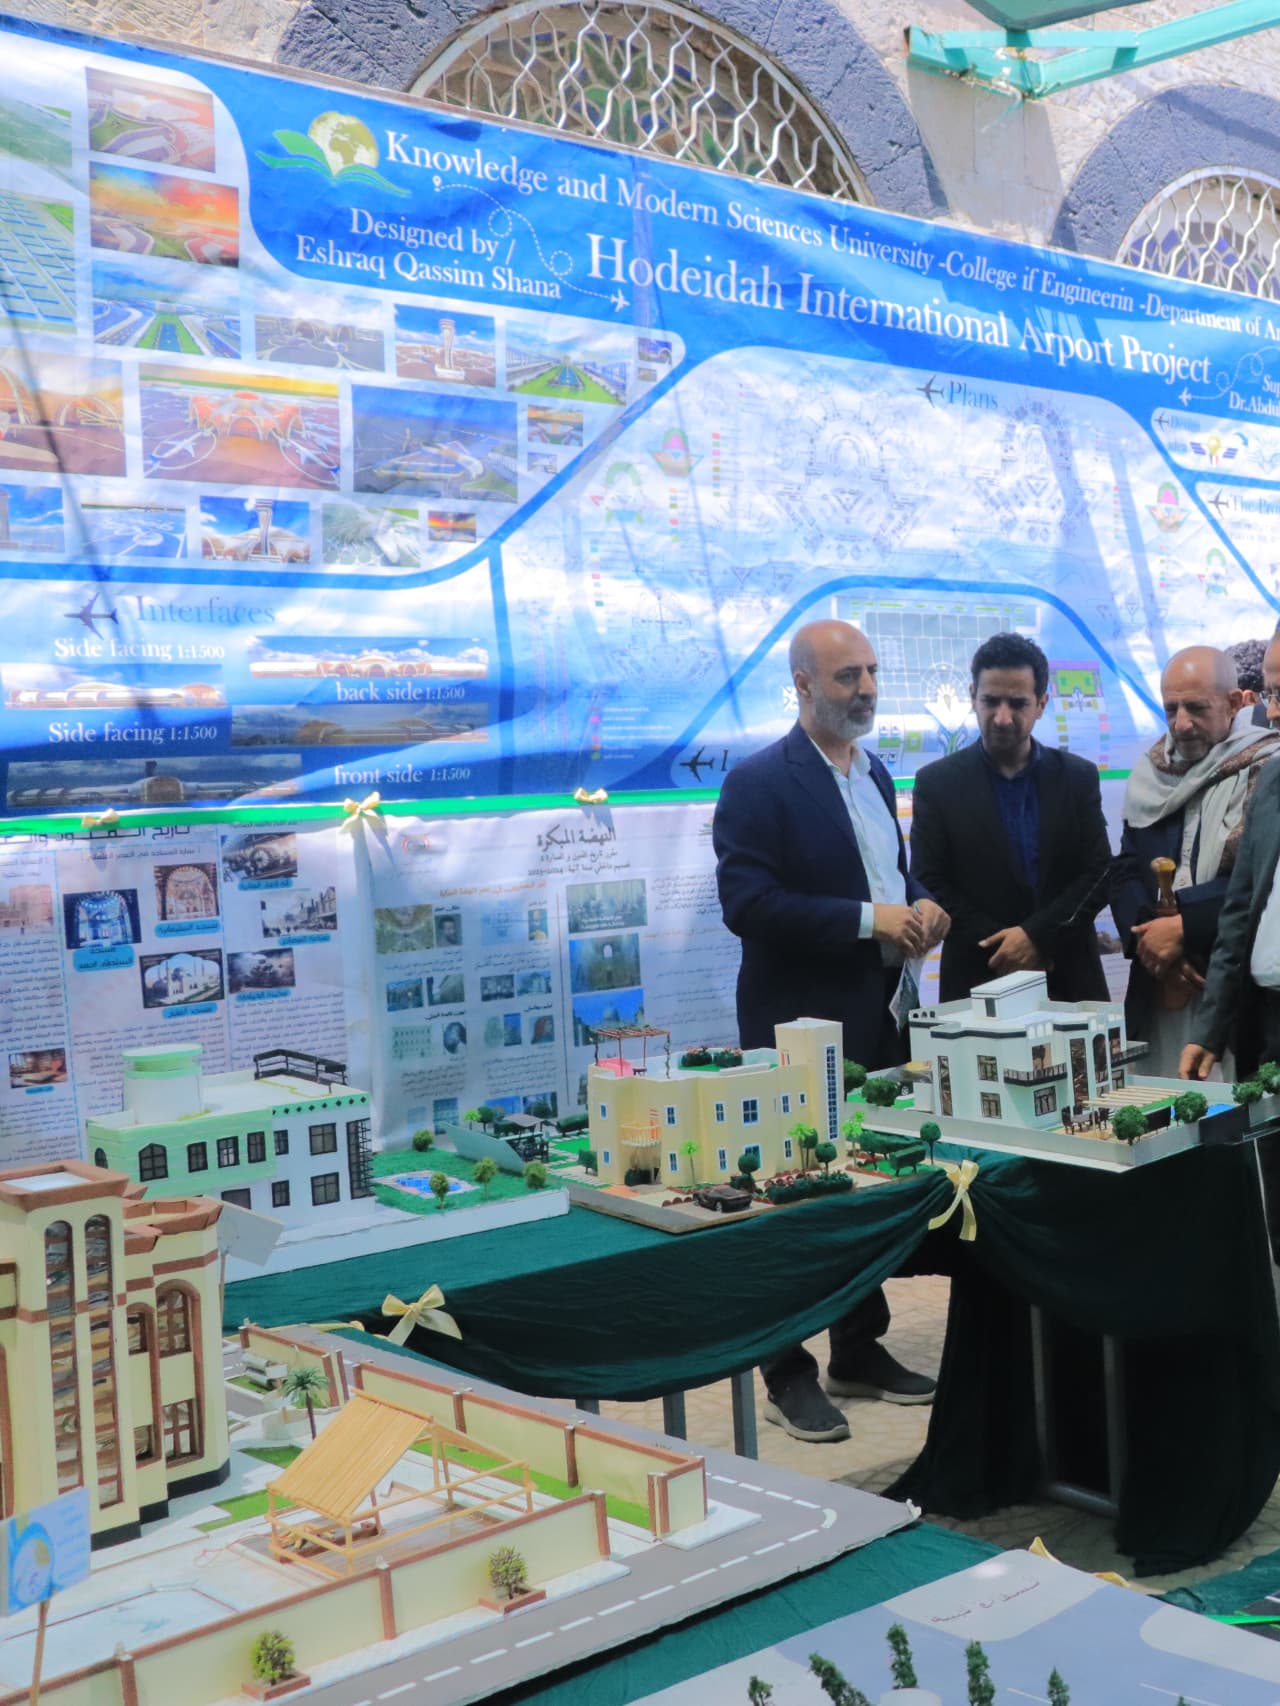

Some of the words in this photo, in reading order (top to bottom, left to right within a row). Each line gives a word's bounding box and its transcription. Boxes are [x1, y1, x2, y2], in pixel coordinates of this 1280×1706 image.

[351, 207, 463, 251] Designed
[471, 229, 499, 262] by
[385, 130, 548, 195] Knowledge
[557, 163, 608, 203] and
[617, 178, 718, 226] Modern
[726, 202, 822, 246] Sciences
[829, 223, 934, 275] University
[938, 250, 1016, 291] -College
[1022, 265, 1040, 292] if
[1041, 269, 1134, 312] Engineerin
[1140, 294, 1241, 333] -Department
[1245, 319, 1262, 338] of
[296, 235, 386, 279] Eshraq
[393, 252, 485, 288] Qassim
[492, 266, 562, 299] Shana
[586, 233, 784, 310] Hodeidah
[797, 271, 1010, 348] International
[1020, 317, 1116, 366] Arport
[1120, 334, 1211, 384] Project
[948, 381, 998, 409] Plans
[136, 595, 275, 624] Interfaces
[55, 638, 102, 657] Side
[110, 638, 172, 660] facing
[178, 644, 225, 660] 1:1500
[337, 681, 380, 701] back
[386, 681, 423, 700] side
[426, 685, 465, 700] 1:1500
[49, 722, 96, 743] Side
[104, 723, 163, 746] facing
[170, 725, 217, 740] 1:1500
[335, 763, 379, 785] front
[385, 763, 423, 782] side
[430, 767, 470, 782] 1:1500
[537, 824, 575, 852] المبكرة
